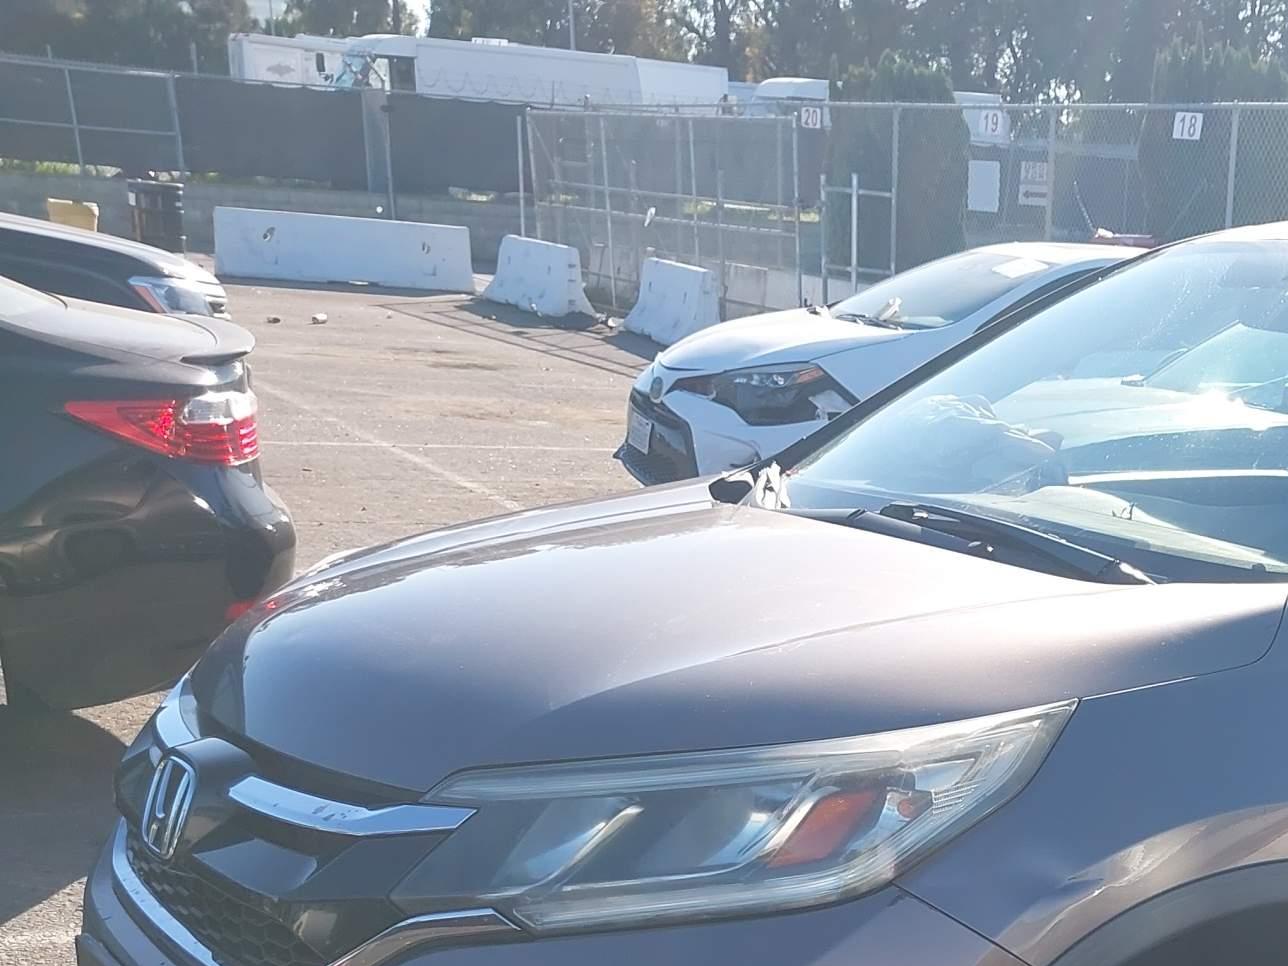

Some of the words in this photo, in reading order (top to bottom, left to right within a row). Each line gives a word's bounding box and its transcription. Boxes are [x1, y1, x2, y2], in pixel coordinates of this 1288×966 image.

[804, 108, 818, 127] 20
[983, 112, 999, 133] 19
[1179, 114, 1197, 138] 18
